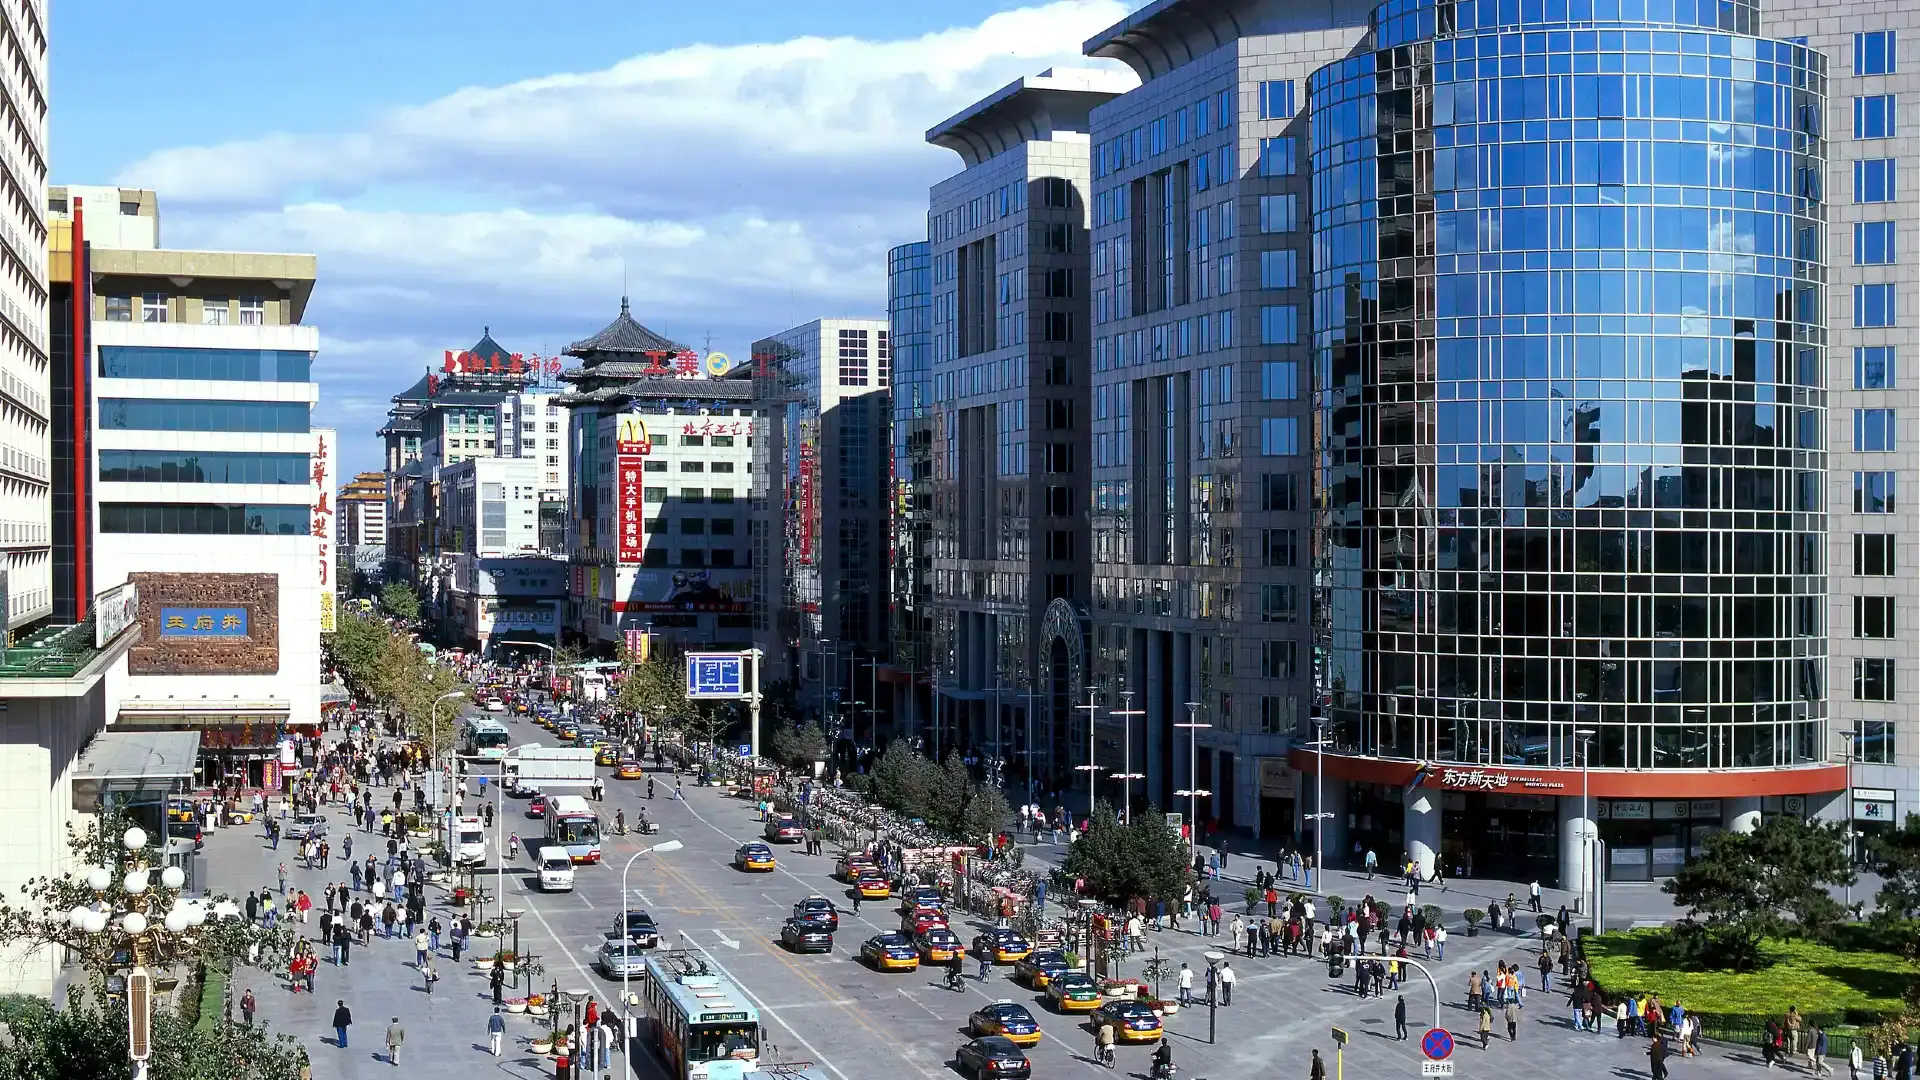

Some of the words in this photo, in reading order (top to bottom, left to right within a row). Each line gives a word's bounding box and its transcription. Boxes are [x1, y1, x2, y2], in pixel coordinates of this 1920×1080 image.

[643, 350, 700, 375] 工美
[625, 470, 637, 547] 特大手机卖场
[165, 613, 242, 632] 王府井
[741, 746, 749, 755] P
[1442, 768, 1509, 790] 东方新天地
[1423, 1063, 1452, 1073] 王府井大街
